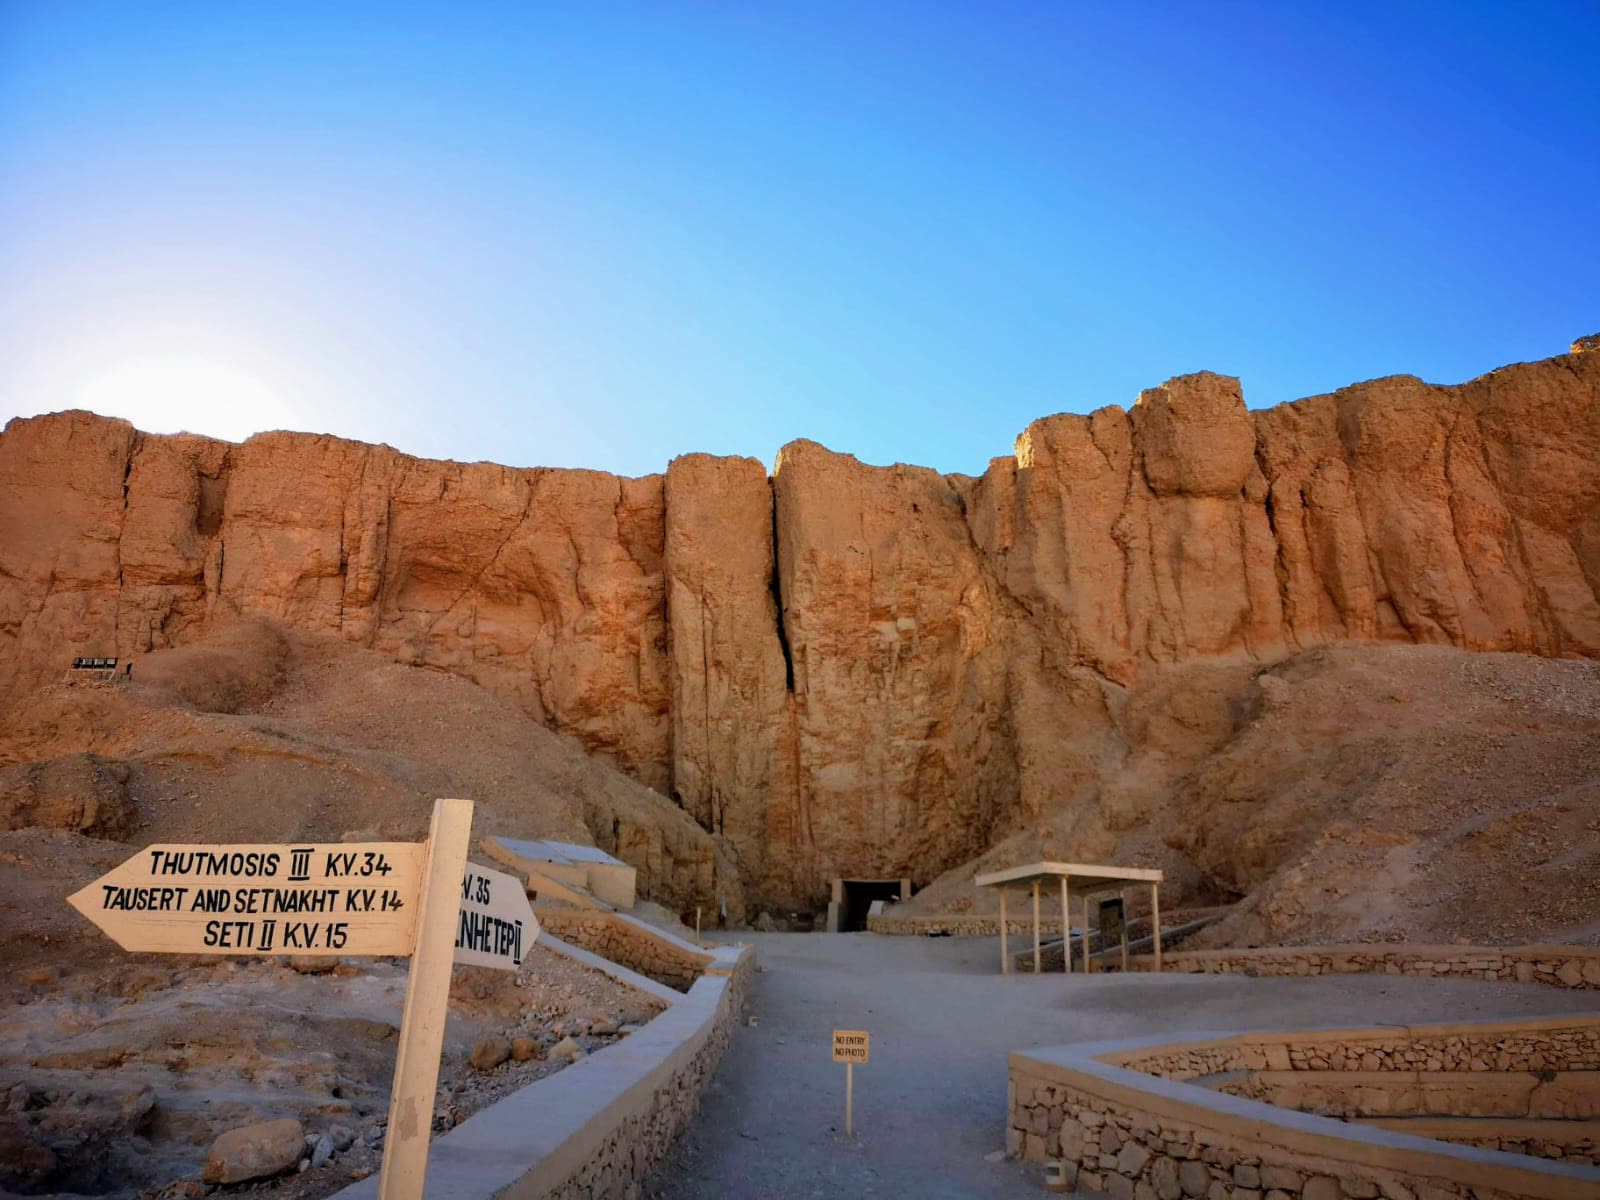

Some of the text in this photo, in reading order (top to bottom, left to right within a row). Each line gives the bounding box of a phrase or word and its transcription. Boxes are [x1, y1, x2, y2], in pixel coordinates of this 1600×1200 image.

[151, 851, 280, 877] THUTMOSIS
[287, 848, 315, 881] III
[102, 885, 189, 911] TAUSERT
[191, 889, 231, 912] AND
[234, 888, 340, 914] SETNAKHT
[204, 920, 255, 948] SETI
[256, 919, 277, 951] II
[835, 1047, 866, 1057] NO PHOTO
[836, 1036, 865, 1045] NO ENTRY
